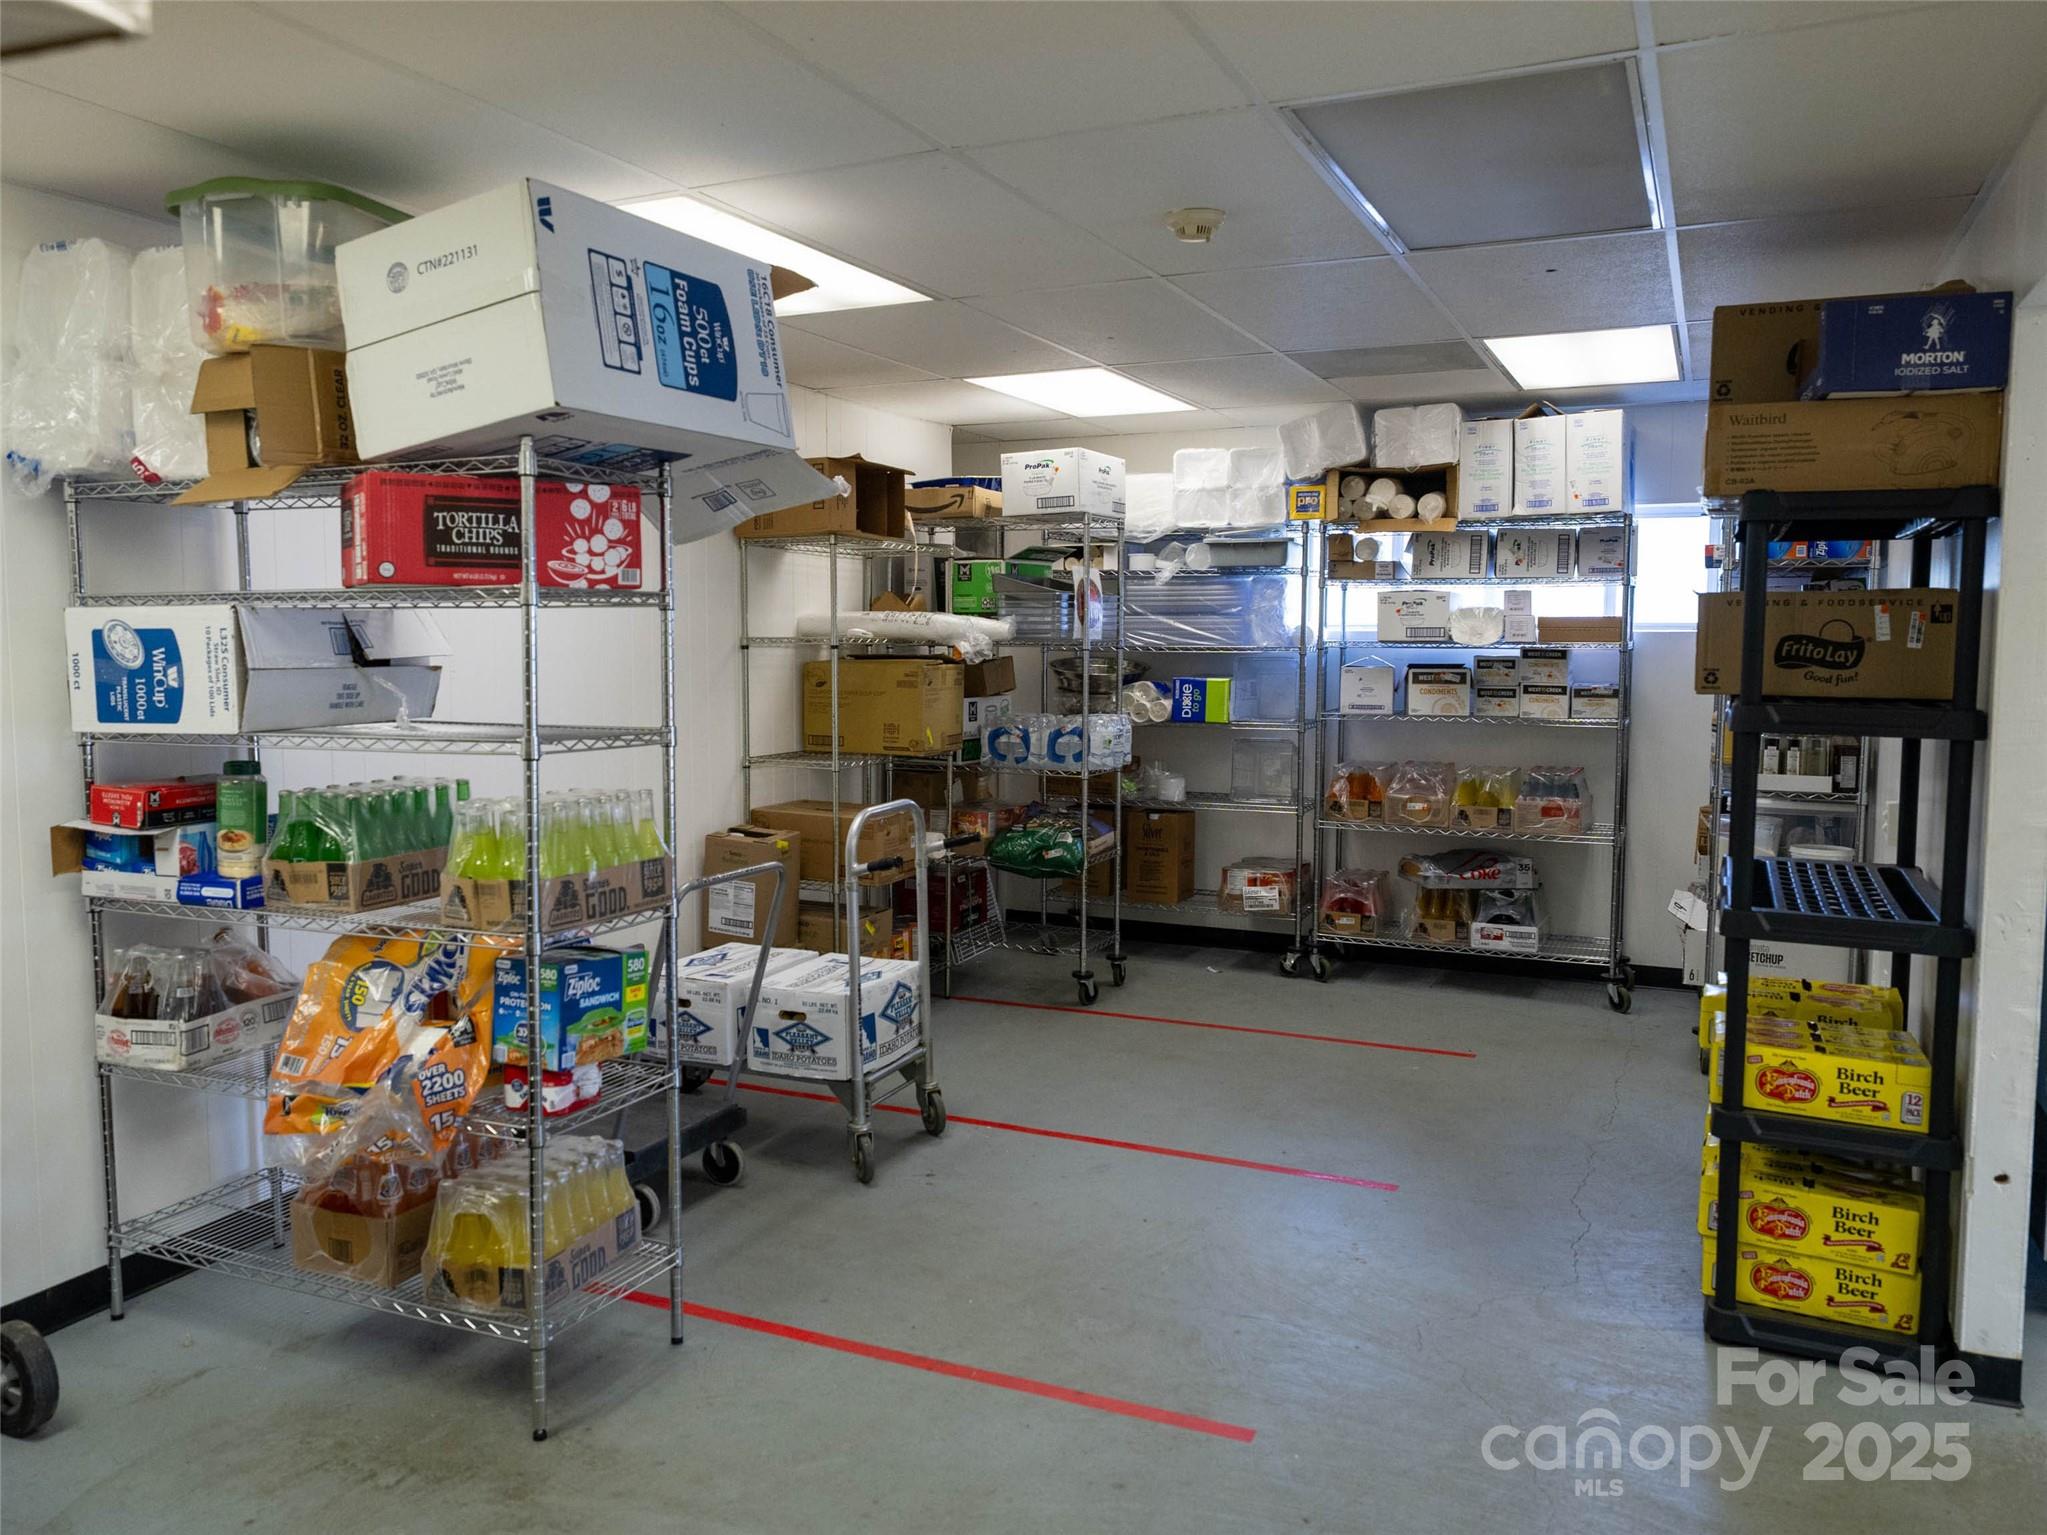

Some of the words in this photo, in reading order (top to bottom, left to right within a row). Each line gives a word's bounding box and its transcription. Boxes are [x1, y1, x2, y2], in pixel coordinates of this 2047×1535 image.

[417, 244, 479, 276] CTN#221131
[1740, 305, 1805, 317] VENDING
[674, 277, 694, 333] Foam
[684, 335, 700, 388] Cups
[768, 320, 783, 389] Consumer
[1902, 351, 1965, 364] MORTON
[1895, 366, 1939, 377] IODIZED
[1943, 364, 1969, 375] SALT
[334, 369, 347, 408] CLEAR
[1729, 413, 1787, 426] Waitbird
[612, 502, 618, 512] 2
[433, 511, 520, 534] TORTILLA
[452, 527, 504, 545] CHIPS
[436, 544, 486, 554] TRADITIONAL
[219, 627, 228, 656] L325
[72, 652, 80, 680] 1000
[74, 680, 81, 691] ct
[152, 647, 169, 708] WinCup
[221, 655, 230, 712] Consumer
[1804, 671, 1833, 684] Good
[1835, 671, 1859, 686] fun!
[135, 677, 147, 721] 1000ct
[1193, 688, 1202, 702] go
[1518, 863, 1530, 872] 35
[627, 957, 645, 972] 580
[1750, 951, 1784, 965] ETCHUP
[497, 970, 522, 986] Ziploc
[1689, 969, 1695, 981] 6
[355, 976, 369, 1006] 150
[567, 977, 601, 997] Ziploc
[579, 991, 620, 1009] SANDWICH
[417, 1063, 446, 1081] OVER
[1836, 1067, 1885, 1086] Birch
[421, 1069, 465, 1097] 2200
[1839, 1082, 1881, 1099] Beer
[425, 1087, 466, 1107] SHEETS
[1906, 1094, 1923, 1106] 12
[429, 1110, 456, 1132] 15
[1832, 1206, 1880, 1226] Birch
[1834, 1220, 1875, 1239] Beer
[1835, 1268, 1883, 1288] Birch
[1837, 1282, 1879, 1300] Beer
